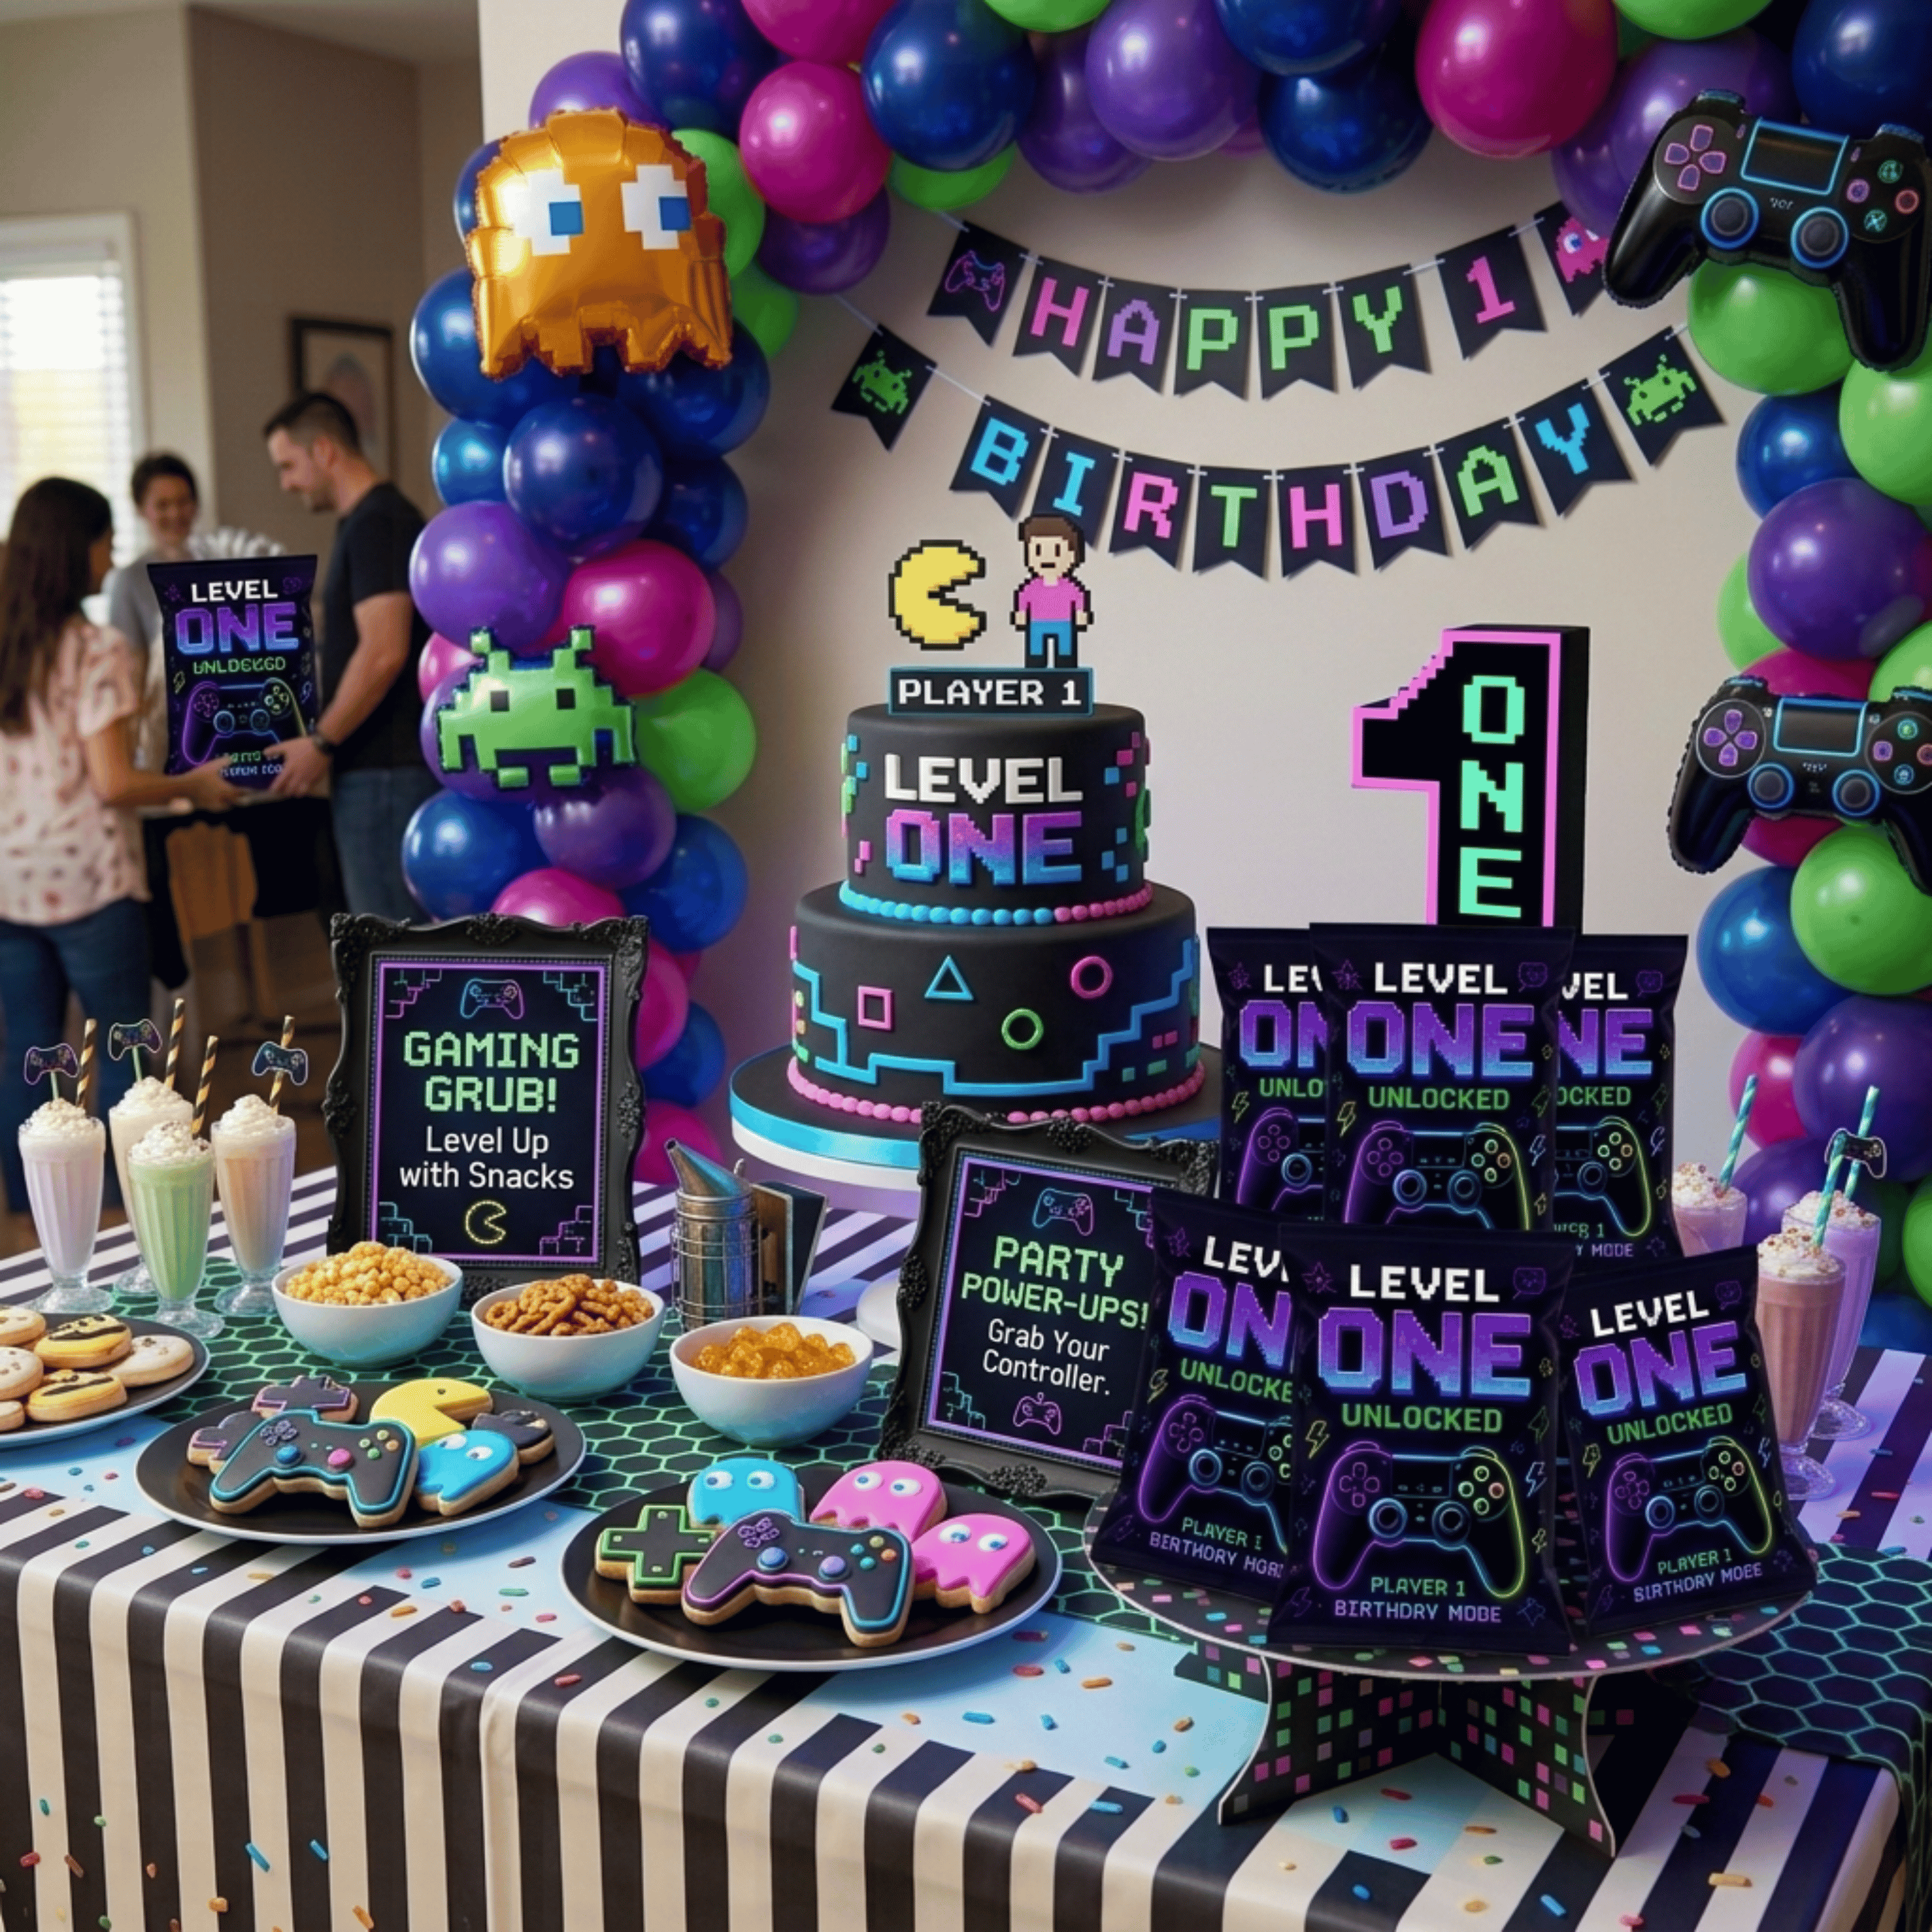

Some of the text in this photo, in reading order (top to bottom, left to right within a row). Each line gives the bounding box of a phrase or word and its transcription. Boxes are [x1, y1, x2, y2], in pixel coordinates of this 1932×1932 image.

[1030, 256, 1515, 371] HAPPY 1
[970, 402, 1590, 549] BIRTHDAY
[192, 580, 278, 602] LEVEL
[175, 601, 299, 655] ONE
[898, 679, 1082, 706] PLAYER 1
[884, 753, 1083, 804] LEVEL
[1459, 675, 1525, 918] ONE
[886, 809, 1083, 886] ONE
[1374, 962, 1508, 994] LEVEL
[404, 1032, 579, 1068] GAMING
[1347, 1000, 1534, 1077] ONE
[424, 1076, 557, 1112] GRUB!
[1368, 1086, 1510, 1110] UNLOCKED
[426, 1126, 549, 1159] Level Up
[400, 1162, 574, 1189] with Snacks
[993, 1235, 1124, 1287] PARTY
[1591, 1243, 1634, 1257] MODE
[961, 1272, 1150, 1331] POWER-UPS!
[1350, 1264, 1499, 1302] LEVEL
[1168, 1271, 1292, 1367] ON
[1590, 1291, 1710, 1338] LEVEL
[988, 1318, 1110, 1361] Grab Your
[1318, 1307, 1531, 1397] ONE
[983, 1349, 1110, 1395] Controller.
[1180, 1358, 1293, 1403] UNLOCKE
[1573, 1321, 1747, 1416] ONE
[1341, 1403, 1502, 1432] UNLOCKED
[1607, 1403, 1732, 1444] UNLOCKED
[1723, 1548, 1732, 1562] 1
[1370, 1577, 1465, 1597] PLAYER 1
